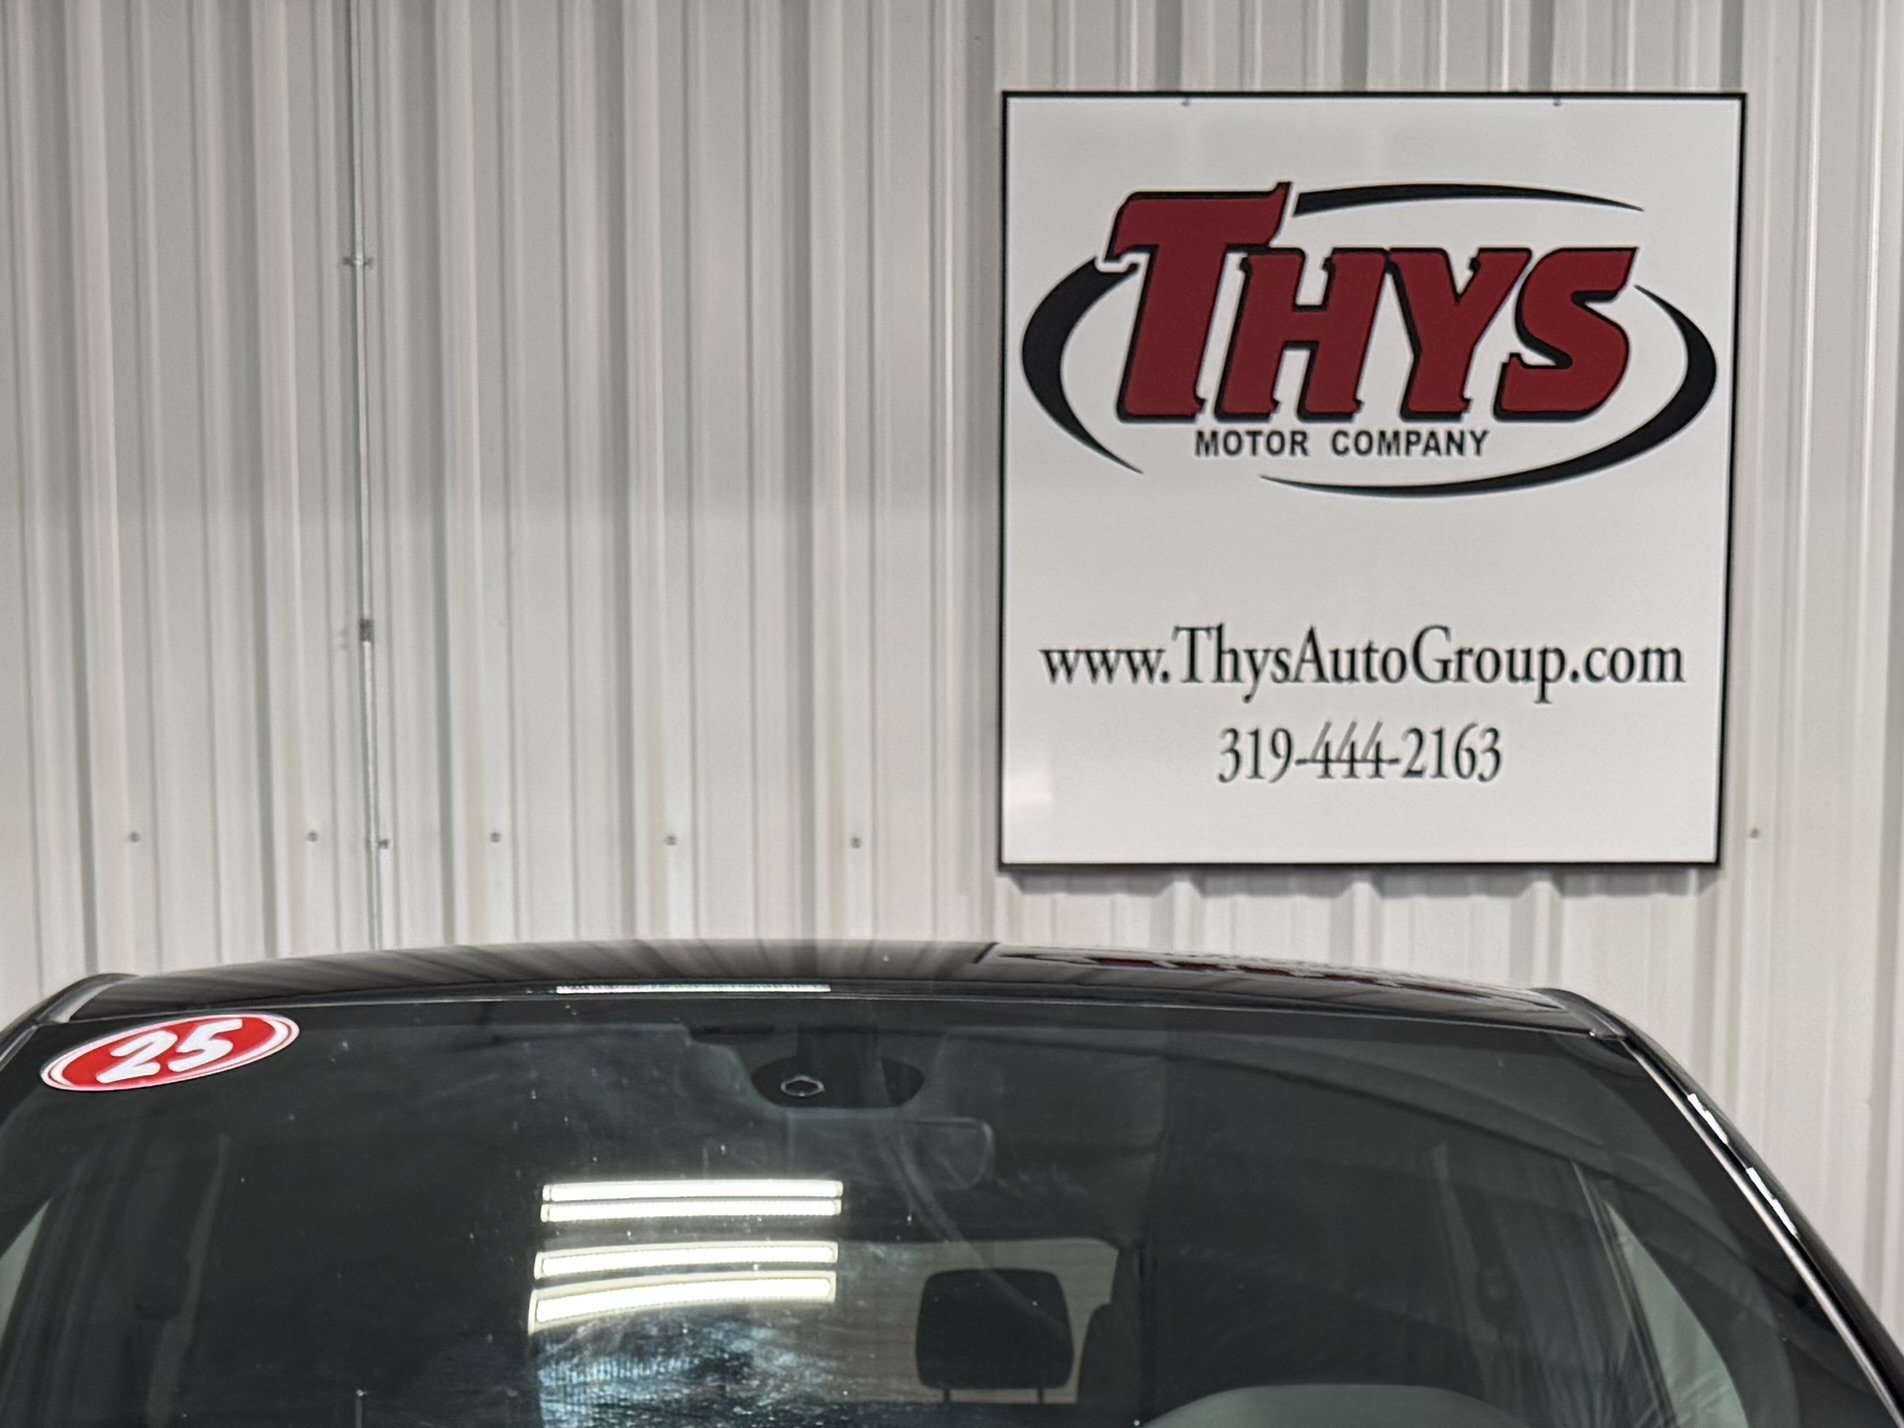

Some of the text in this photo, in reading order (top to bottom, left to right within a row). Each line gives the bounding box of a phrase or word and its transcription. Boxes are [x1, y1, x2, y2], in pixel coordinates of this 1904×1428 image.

[1106, 181, 1639, 422] THYS
[1194, 429, 1490, 457] MOTOR COMPANY
[1039, 623, 1685, 705] www.ThysAutoGroup.com
[1218, 722, 1502, 784] 319-444-2163
[96, 1018, 244, 1085] 25
